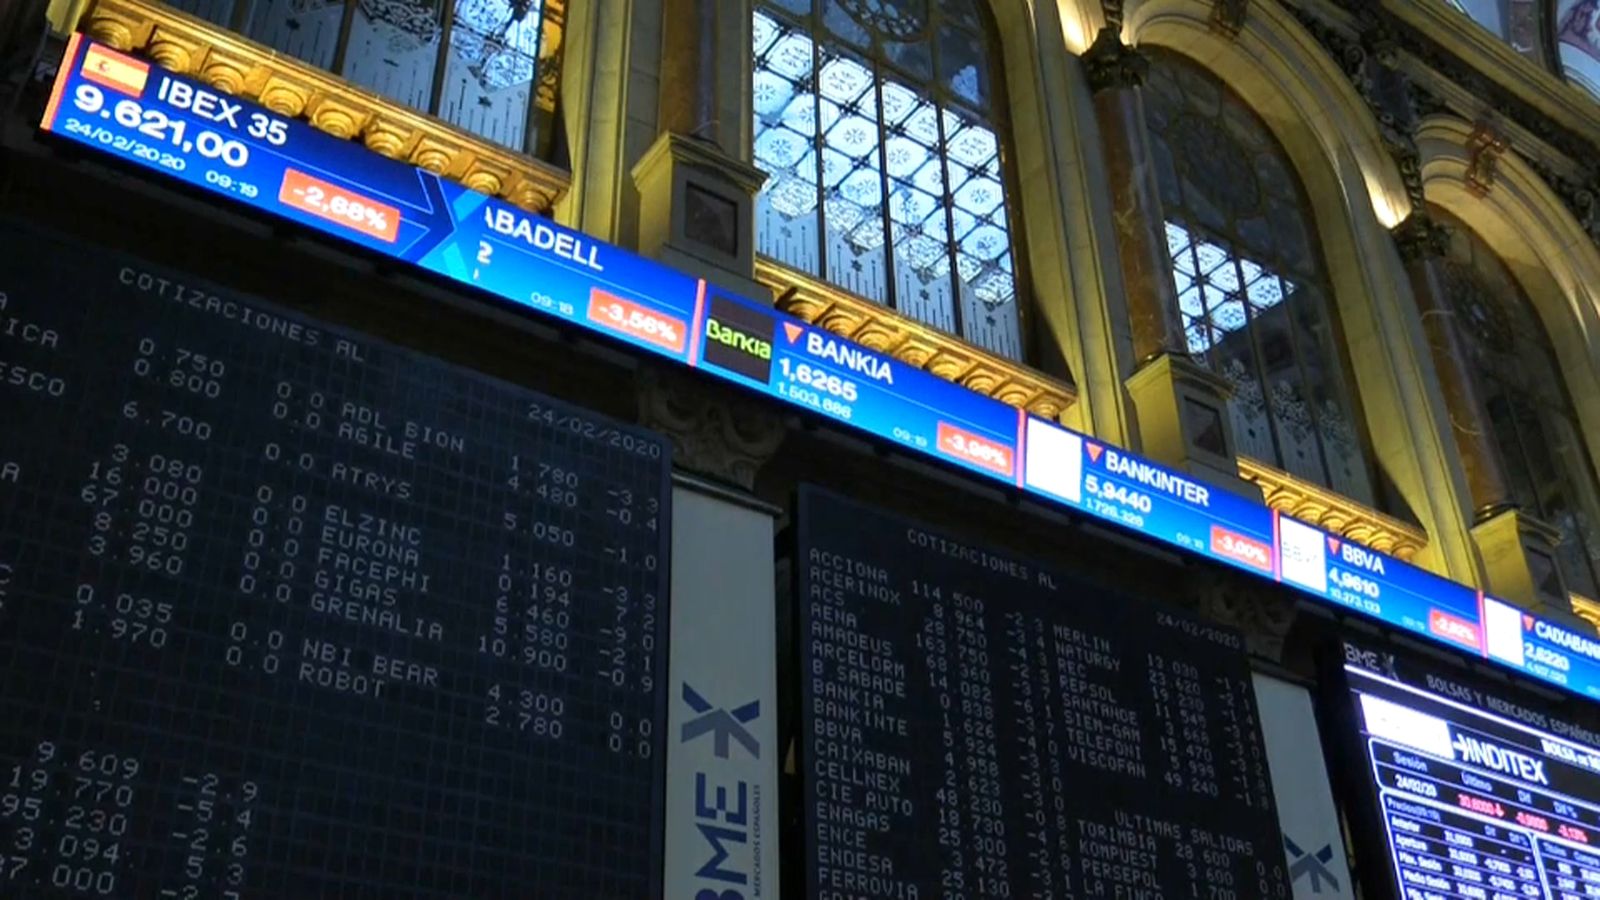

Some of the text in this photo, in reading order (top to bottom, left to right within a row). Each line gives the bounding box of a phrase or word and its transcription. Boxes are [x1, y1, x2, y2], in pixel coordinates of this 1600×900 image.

[73, 83, 249, 168] 9.621,00
[158, 76, 289, 146] IBEX 35
[65, 117, 187, 171] 24/02/2020
[205, 169, 259, 198] 09:19
[119, 266, 365, 362] COTIZACIONES AL
[705, 318, 772, 361] Bankia
[806, 331, 894, 385] BANKIA
[0, 317, 59, 348] ICA
[338, 422, 417, 460] AGILE
[779, 358, 858, 402] 1,6265
[341, 402, 387, 430] ADL
[528, 403, 661, 459] 24/02/2020
[332, 463, 412, 499] ATRYS
[1085, 473, 1152, 513] 5,9440
[1105, 449, 1209, 507] BANKINTER
[325, 505, 422, 546] ELZINC
[321, 526, 420, 568] EURONA
[809, 547, 888, 584] ACCIONA
[907, 528, 1057, 590] COTIZACIONES AL
[1342, 543, 1386, 576] BBVA
[314, 570, 398, 607] GIGAS
[318, 547, 431, 592] FACEPHI
[810, 565, 901, 606] ACERINOX
[810, 584, 845, 607] ACS
[811, 602, 857, 629] AENA
[311, 592, 443, 641] GRENALIA
[812, 619, 894, 657] AMADEUS
[302, 638, 351, 667] NBI
[372, 655, 439, 688] BEAR
[812, 639, 905, 679] ARCELORM
[298, 662, 387, 698] ROBOT
[813, 678, 885, 711] BANKIA
[837, 665, 906, 699] SABADE
[813, 697, 908, 736] BANKINTE
[814, 718, 863, 745] BBVA
[815, 738, 912, 776] CAIXABAN
[815, 759, 901, 793] CELLNEX
[1465, 737, 1549, 786] INDITEX
[816, 780, 852, 804] CIE
[866, 791, 913, 817] AUTO
[816, 801, 891, 832] ENAGAS
[694, 771, 747, 900] ME
[817, 822, 867, 849] ENCE
[0, 854, 115, 895] 7.000
[818, 844, 893, 876] ENDESA
[818, 866, 919, 900] FERROVIA
